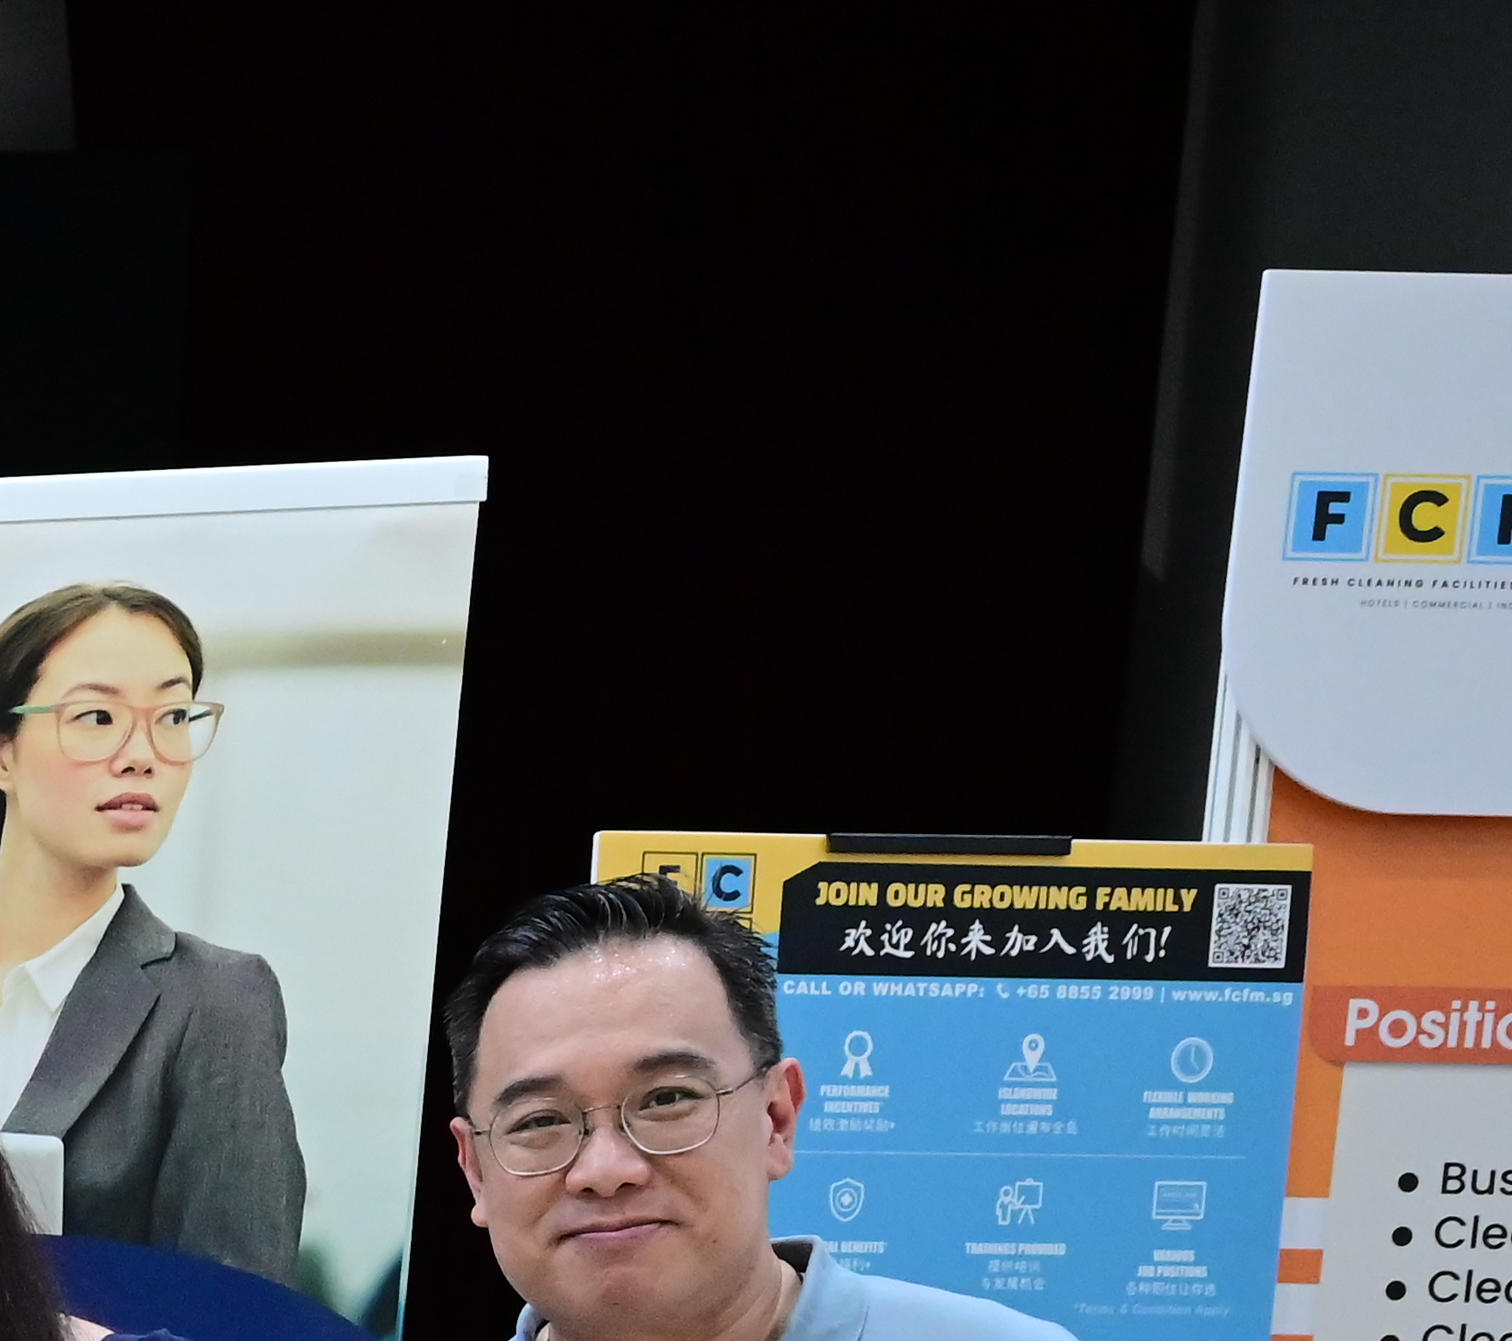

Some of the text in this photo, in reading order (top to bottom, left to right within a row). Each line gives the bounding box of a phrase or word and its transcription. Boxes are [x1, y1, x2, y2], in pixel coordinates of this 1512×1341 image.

[1292, 577, 1339, 586] FRESH
[1347, 578, 1425, 588] CLEANING
[815, 881, 1198, 912] JOIN OUR GROWING FAMILY
[783, 980, 831, 996] CALL
[839, 981, 866, 996] OR
[873, 982, 985, 998] WHATSAPP:
[1016, 984, 1050, 999] +65
[1056, 985, 1102, 1000] 8855
[1171, 987, 1294, 1006] www.fcfm.sg
[1434, 1215, 1512, 1250] Cle
